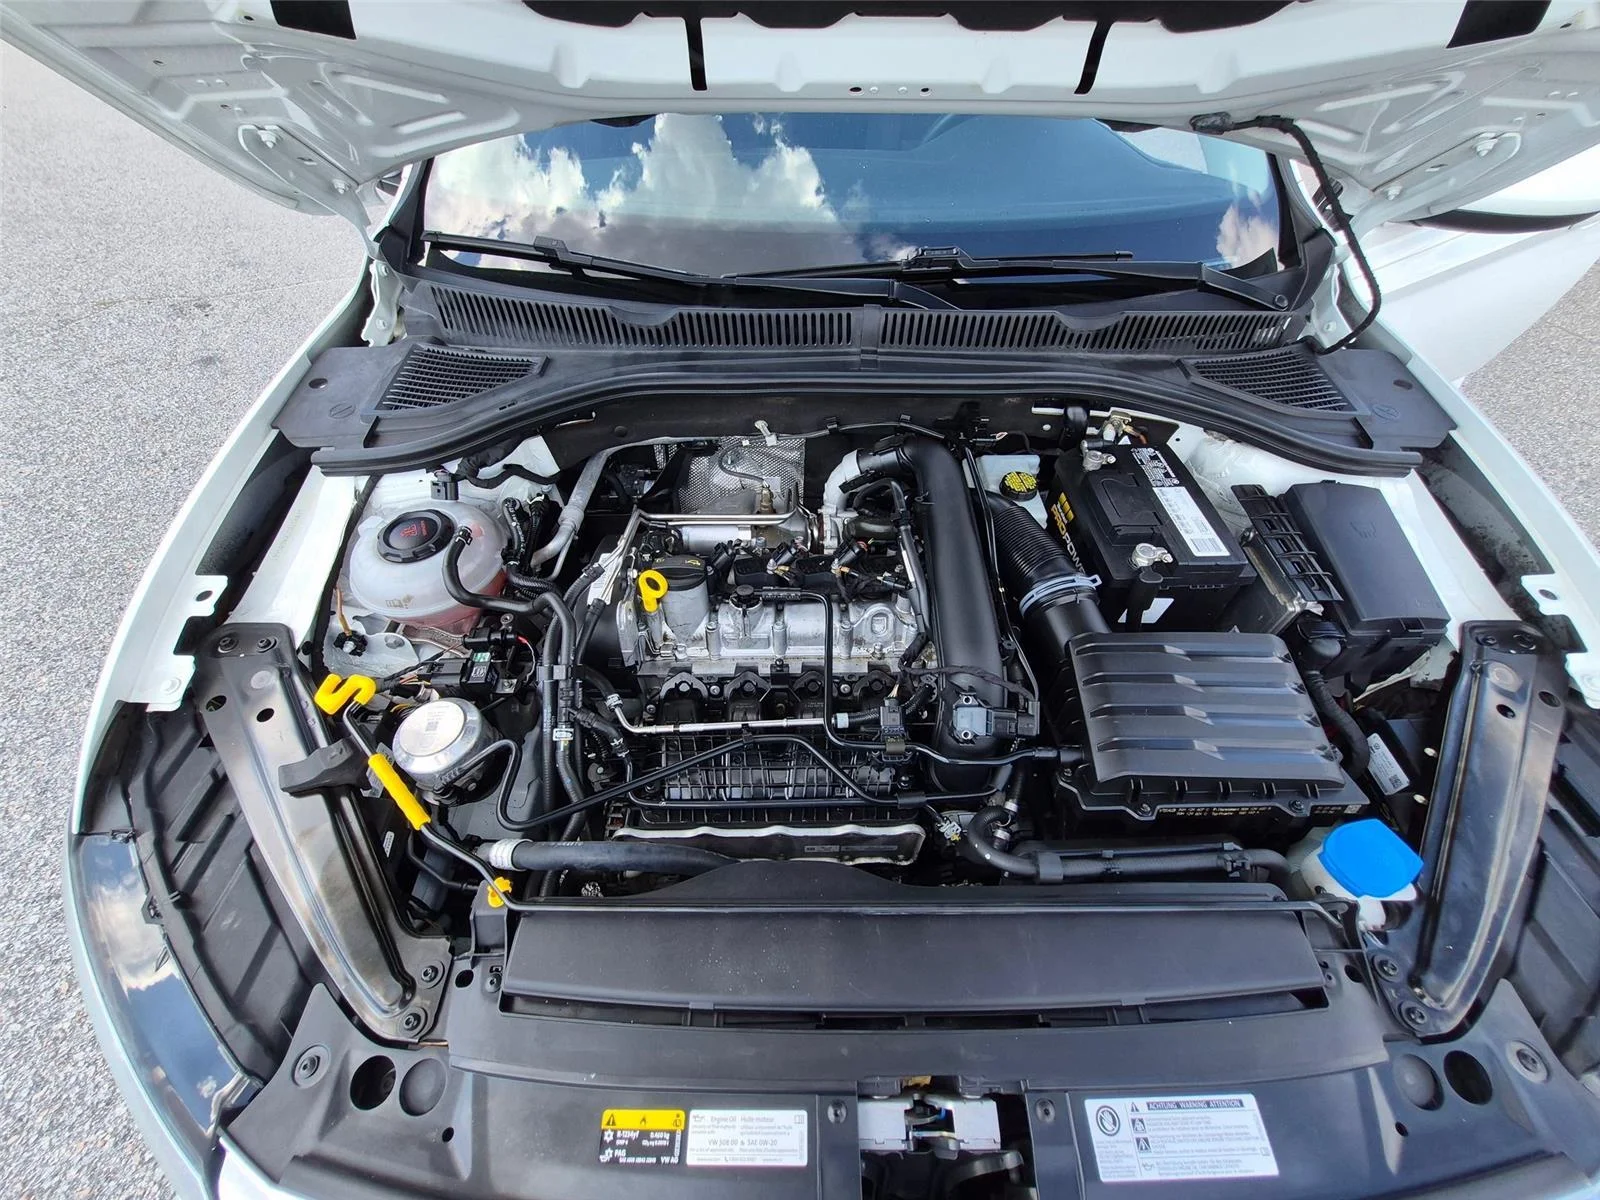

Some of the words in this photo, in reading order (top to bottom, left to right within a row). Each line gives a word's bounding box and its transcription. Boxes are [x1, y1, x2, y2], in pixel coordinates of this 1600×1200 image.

[1149, 1102, 1178, 1110] ACHTUNG
[1179, 1100, 1208, 1109] WARNING
[1209, 1099, 1241, 1108] ATTENTION
[710, 1115, 728, 1124] Engine
[616, 1130, 640, 1141] R-1234yf
[614, 1149, 627, 1157] PAG
[660, 1156, 670, 1164] VW
[670, 1156, 679, 1164] AG
